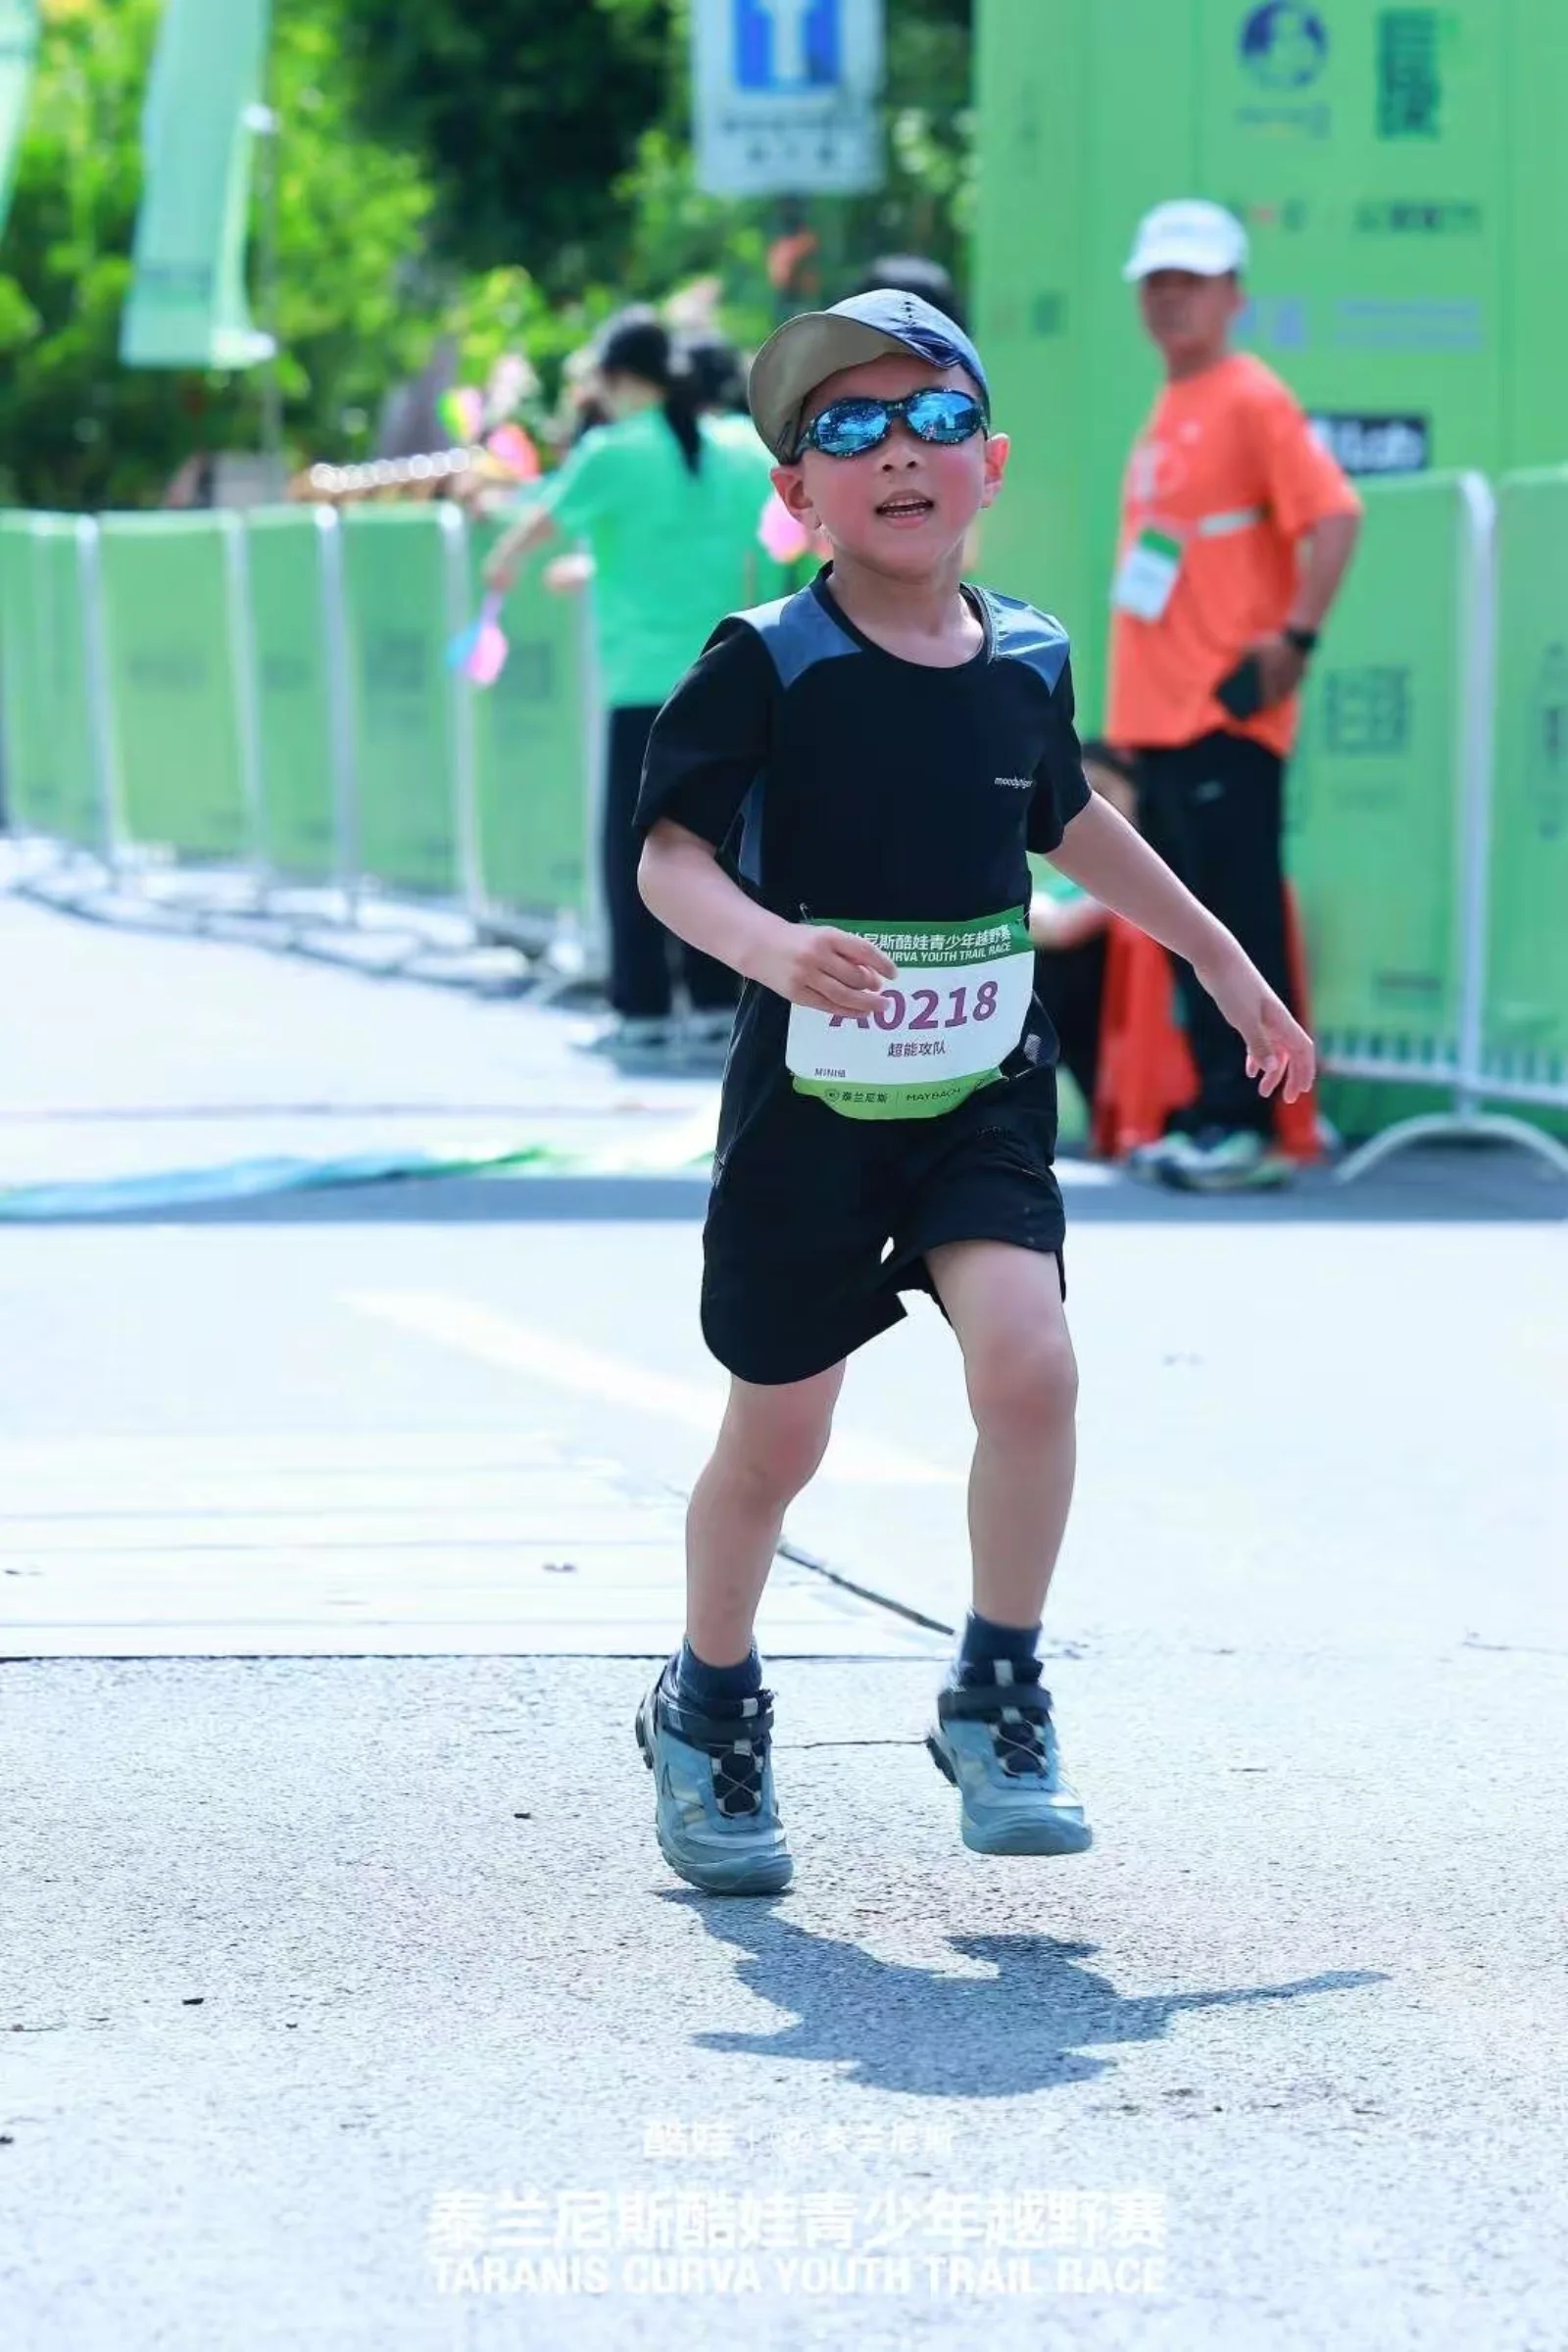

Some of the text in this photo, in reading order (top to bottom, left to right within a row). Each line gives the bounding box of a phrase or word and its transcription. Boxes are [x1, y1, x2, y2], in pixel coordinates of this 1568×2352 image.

[850, 924, 1011, 951] 尼斯酷娃青少年越野赛
[888, 942, 1011, 962] URVA YOUTH TRAIL RACE
[887, 1040, 946, 1057] 超能攻队
